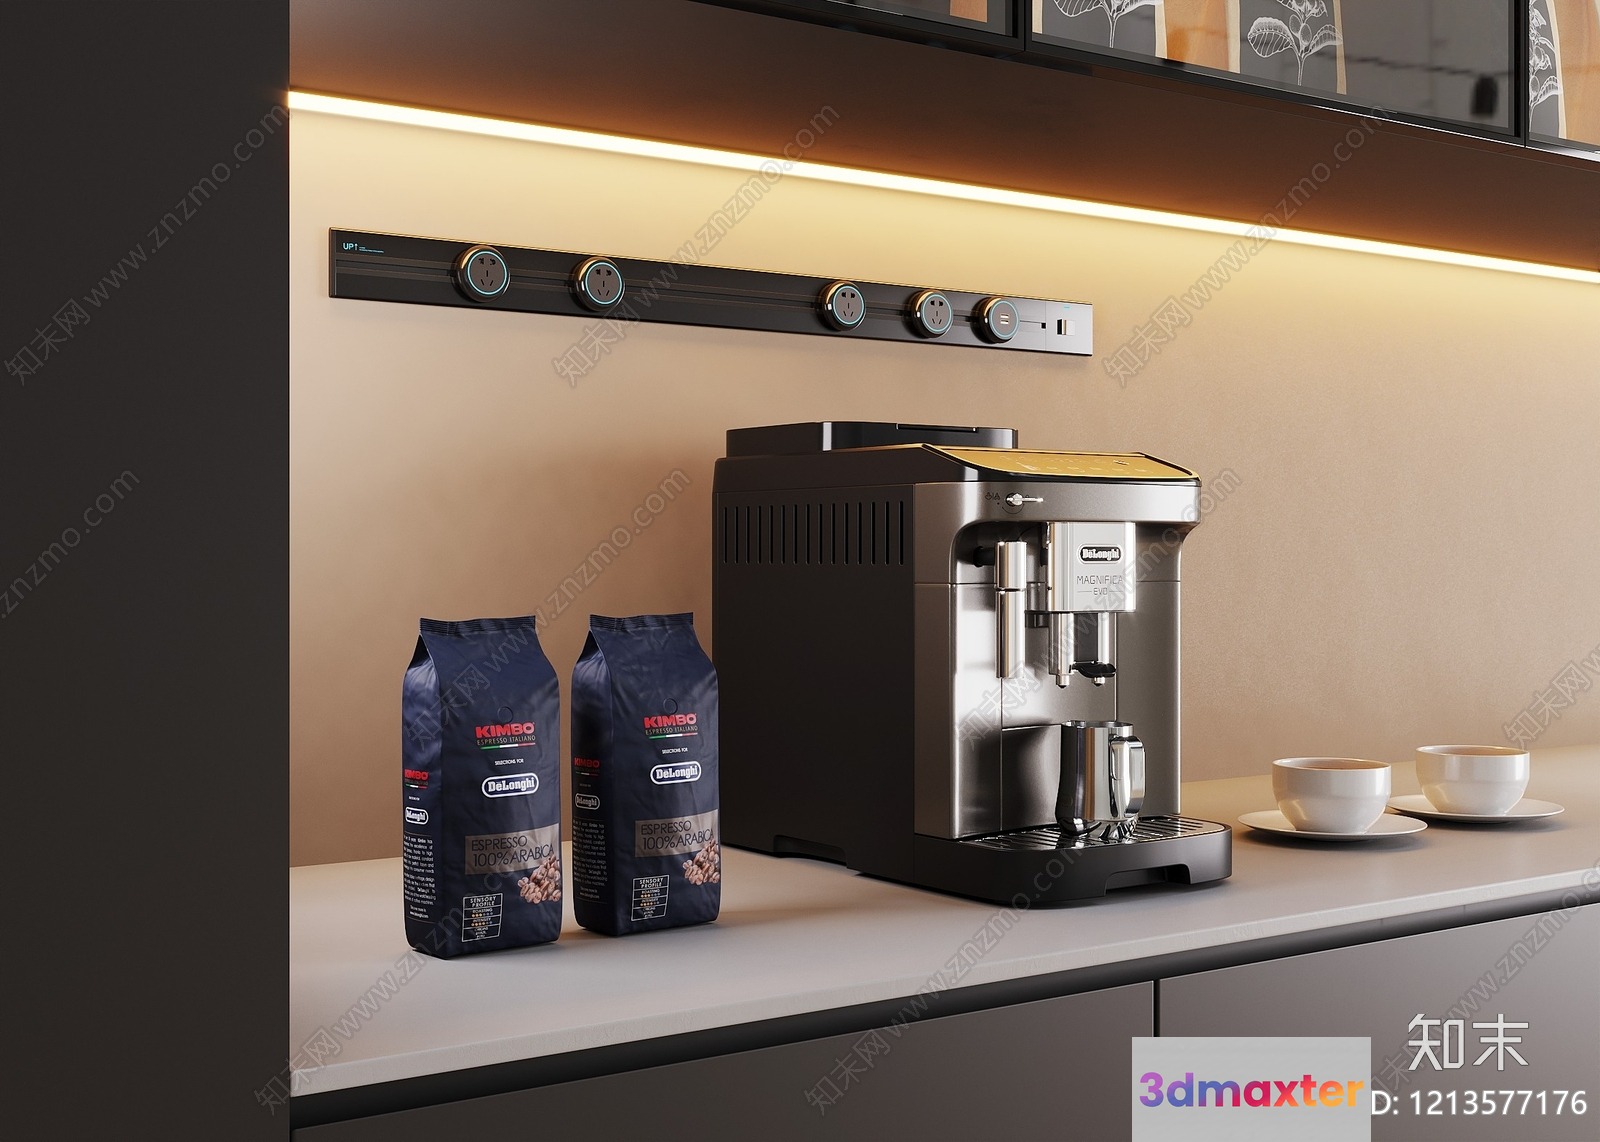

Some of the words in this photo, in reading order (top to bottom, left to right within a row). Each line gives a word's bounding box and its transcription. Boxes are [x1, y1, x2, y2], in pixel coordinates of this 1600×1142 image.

[1076, 575, 1123, 585] MAGNIFICA
[1093, 587, 1108, 595] EVO
[643, 713, 697, 728] KIMBO
[475, 722, 535, 738] KIMBO
[477, 738, 507, 746] ESPRESSO
[641, 820, 691, 836] ESPRESSO
[471, 835, 528, 851] ESPRESSO
